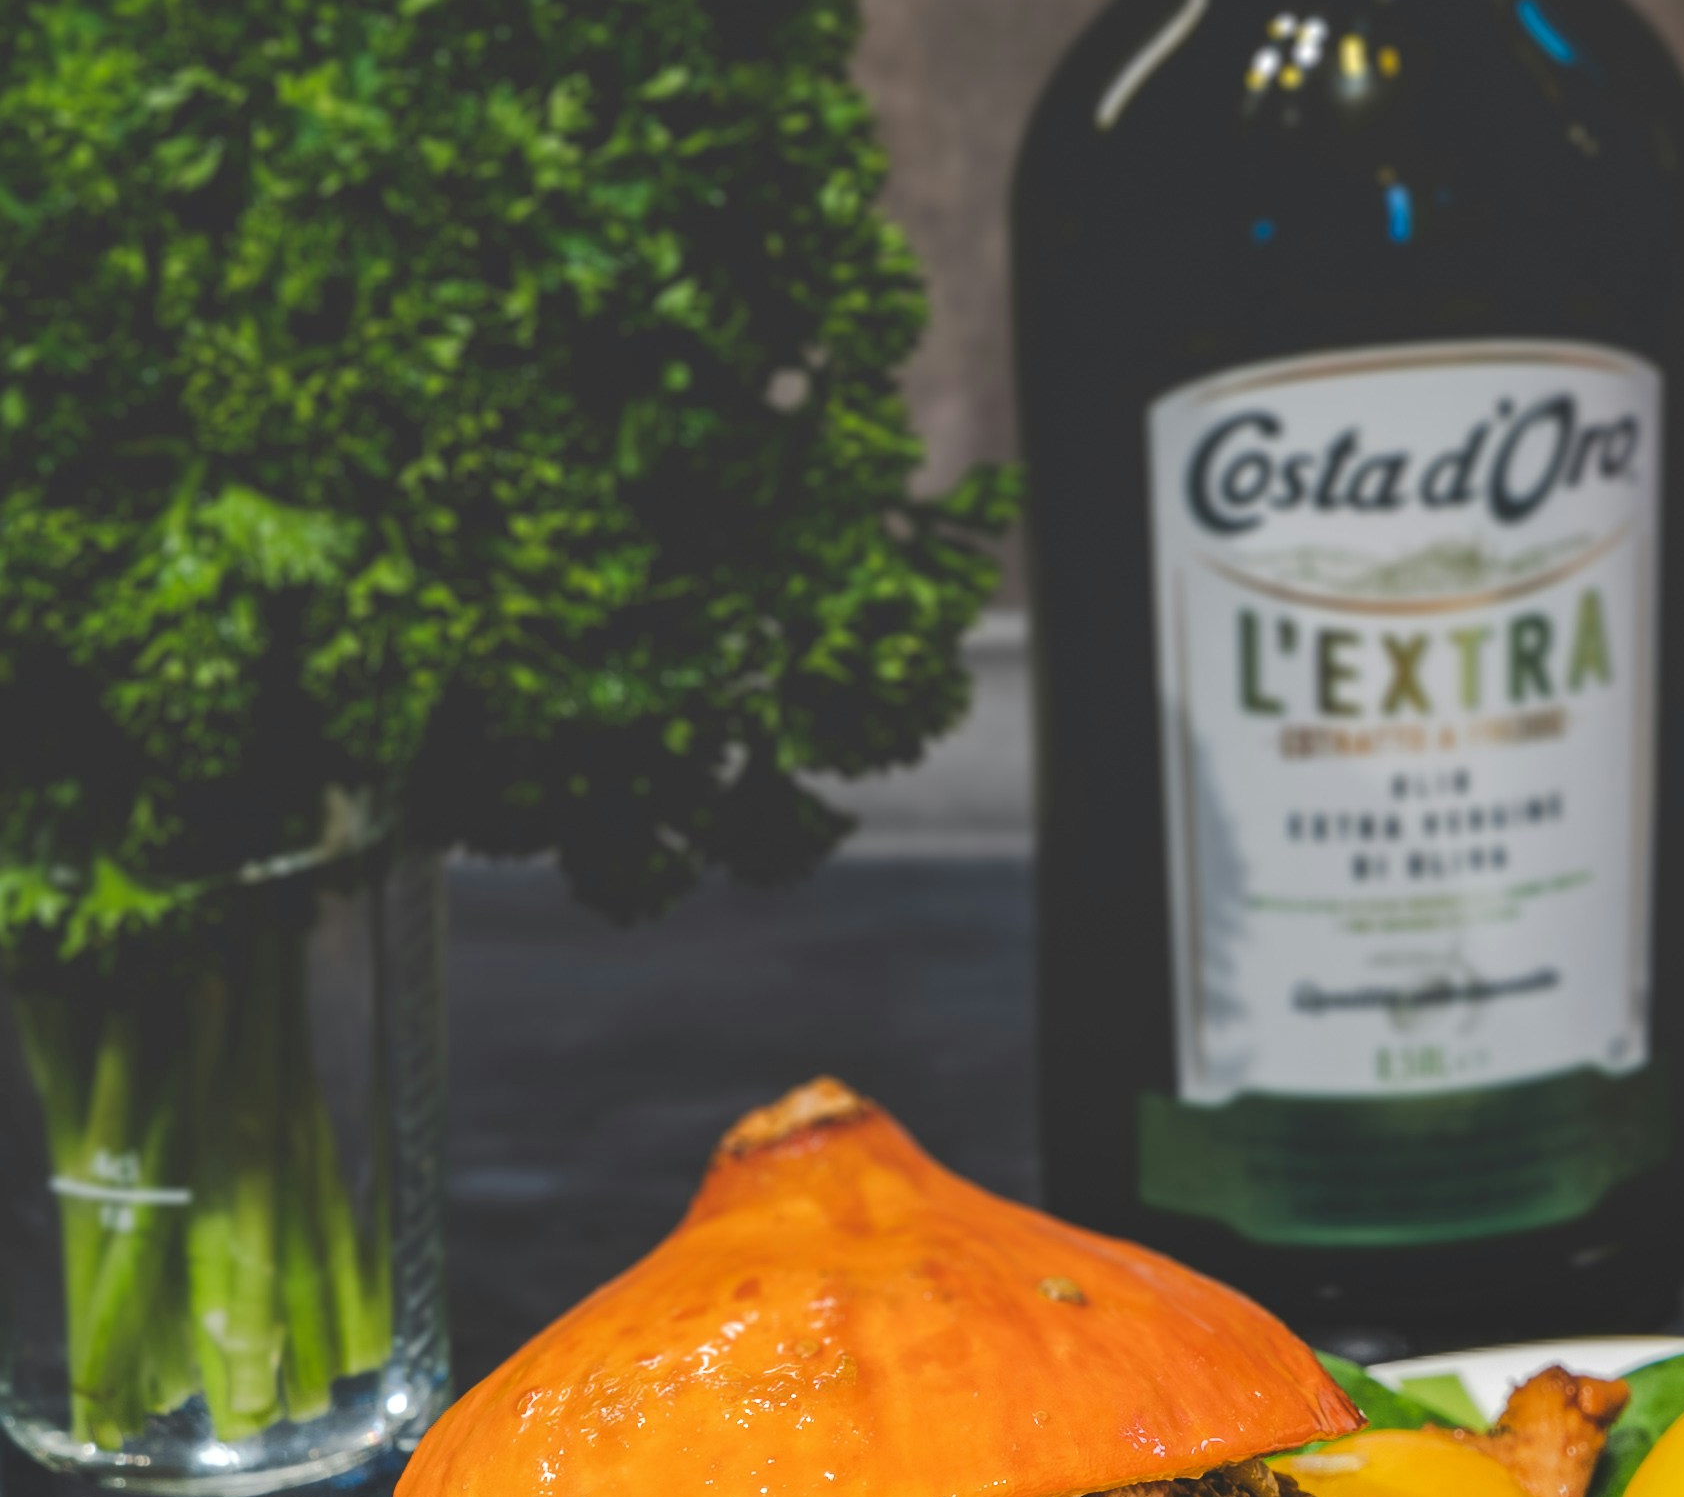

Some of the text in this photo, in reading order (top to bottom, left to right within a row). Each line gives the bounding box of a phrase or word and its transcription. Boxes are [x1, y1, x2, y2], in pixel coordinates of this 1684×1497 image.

[1184, 393, 1640, 539] Costa d'Oro
[1237, 588, 1614, 719] L'EXTRA
[1391, 768, 1470, 802] OLIO
[1286, 810, 1403, 844] EXTRA
